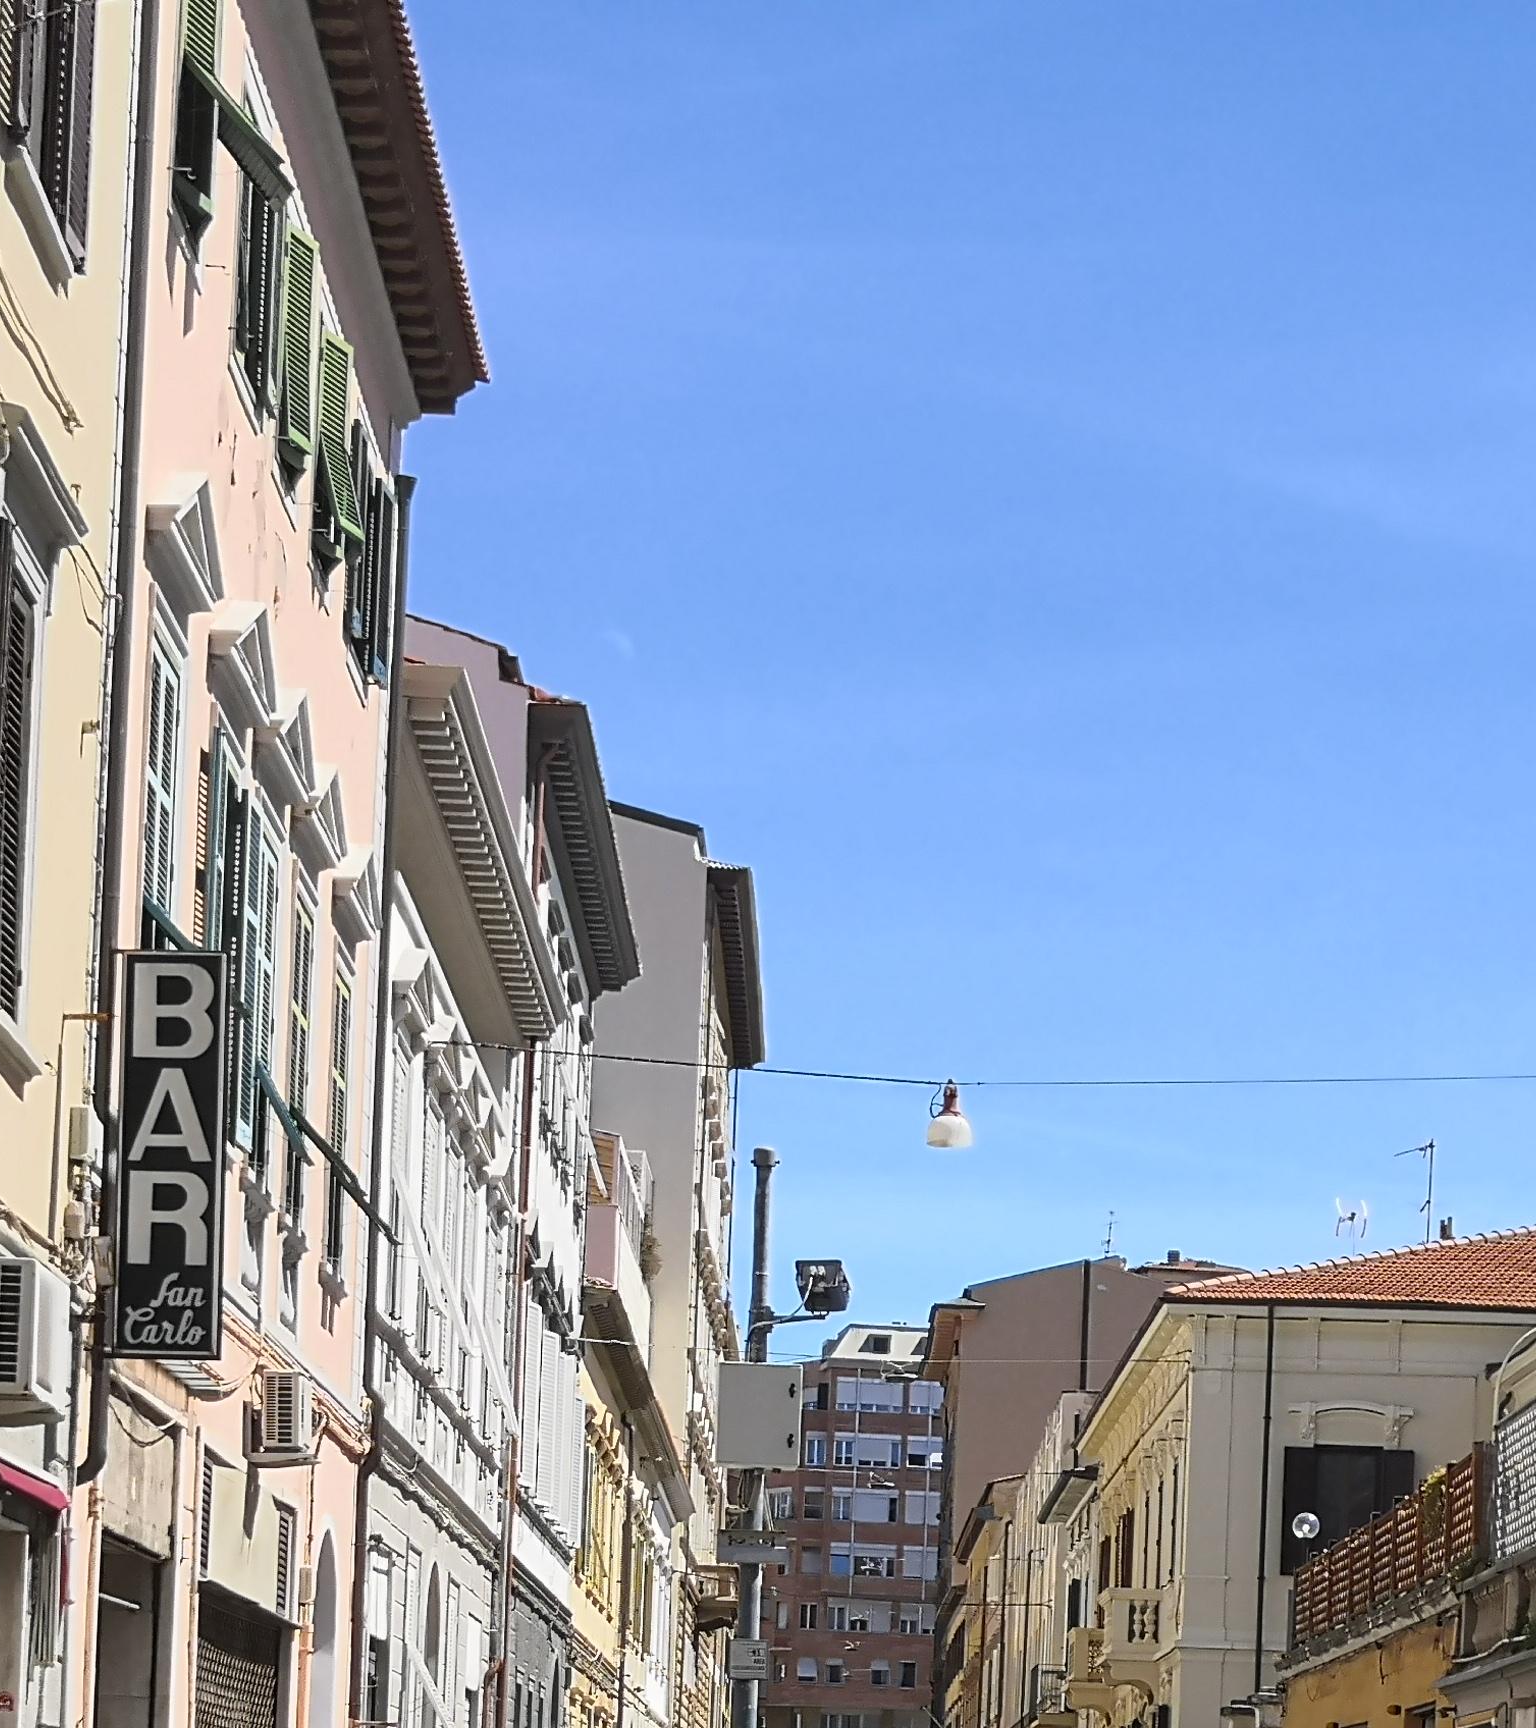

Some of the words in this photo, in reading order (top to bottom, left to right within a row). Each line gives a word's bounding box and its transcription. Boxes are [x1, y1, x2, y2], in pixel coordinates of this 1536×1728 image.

[127, 961, 216, 1267] BAR
[149, 1271, 205, 1308] San
[124, 1306, 208, 1346] Carlo
